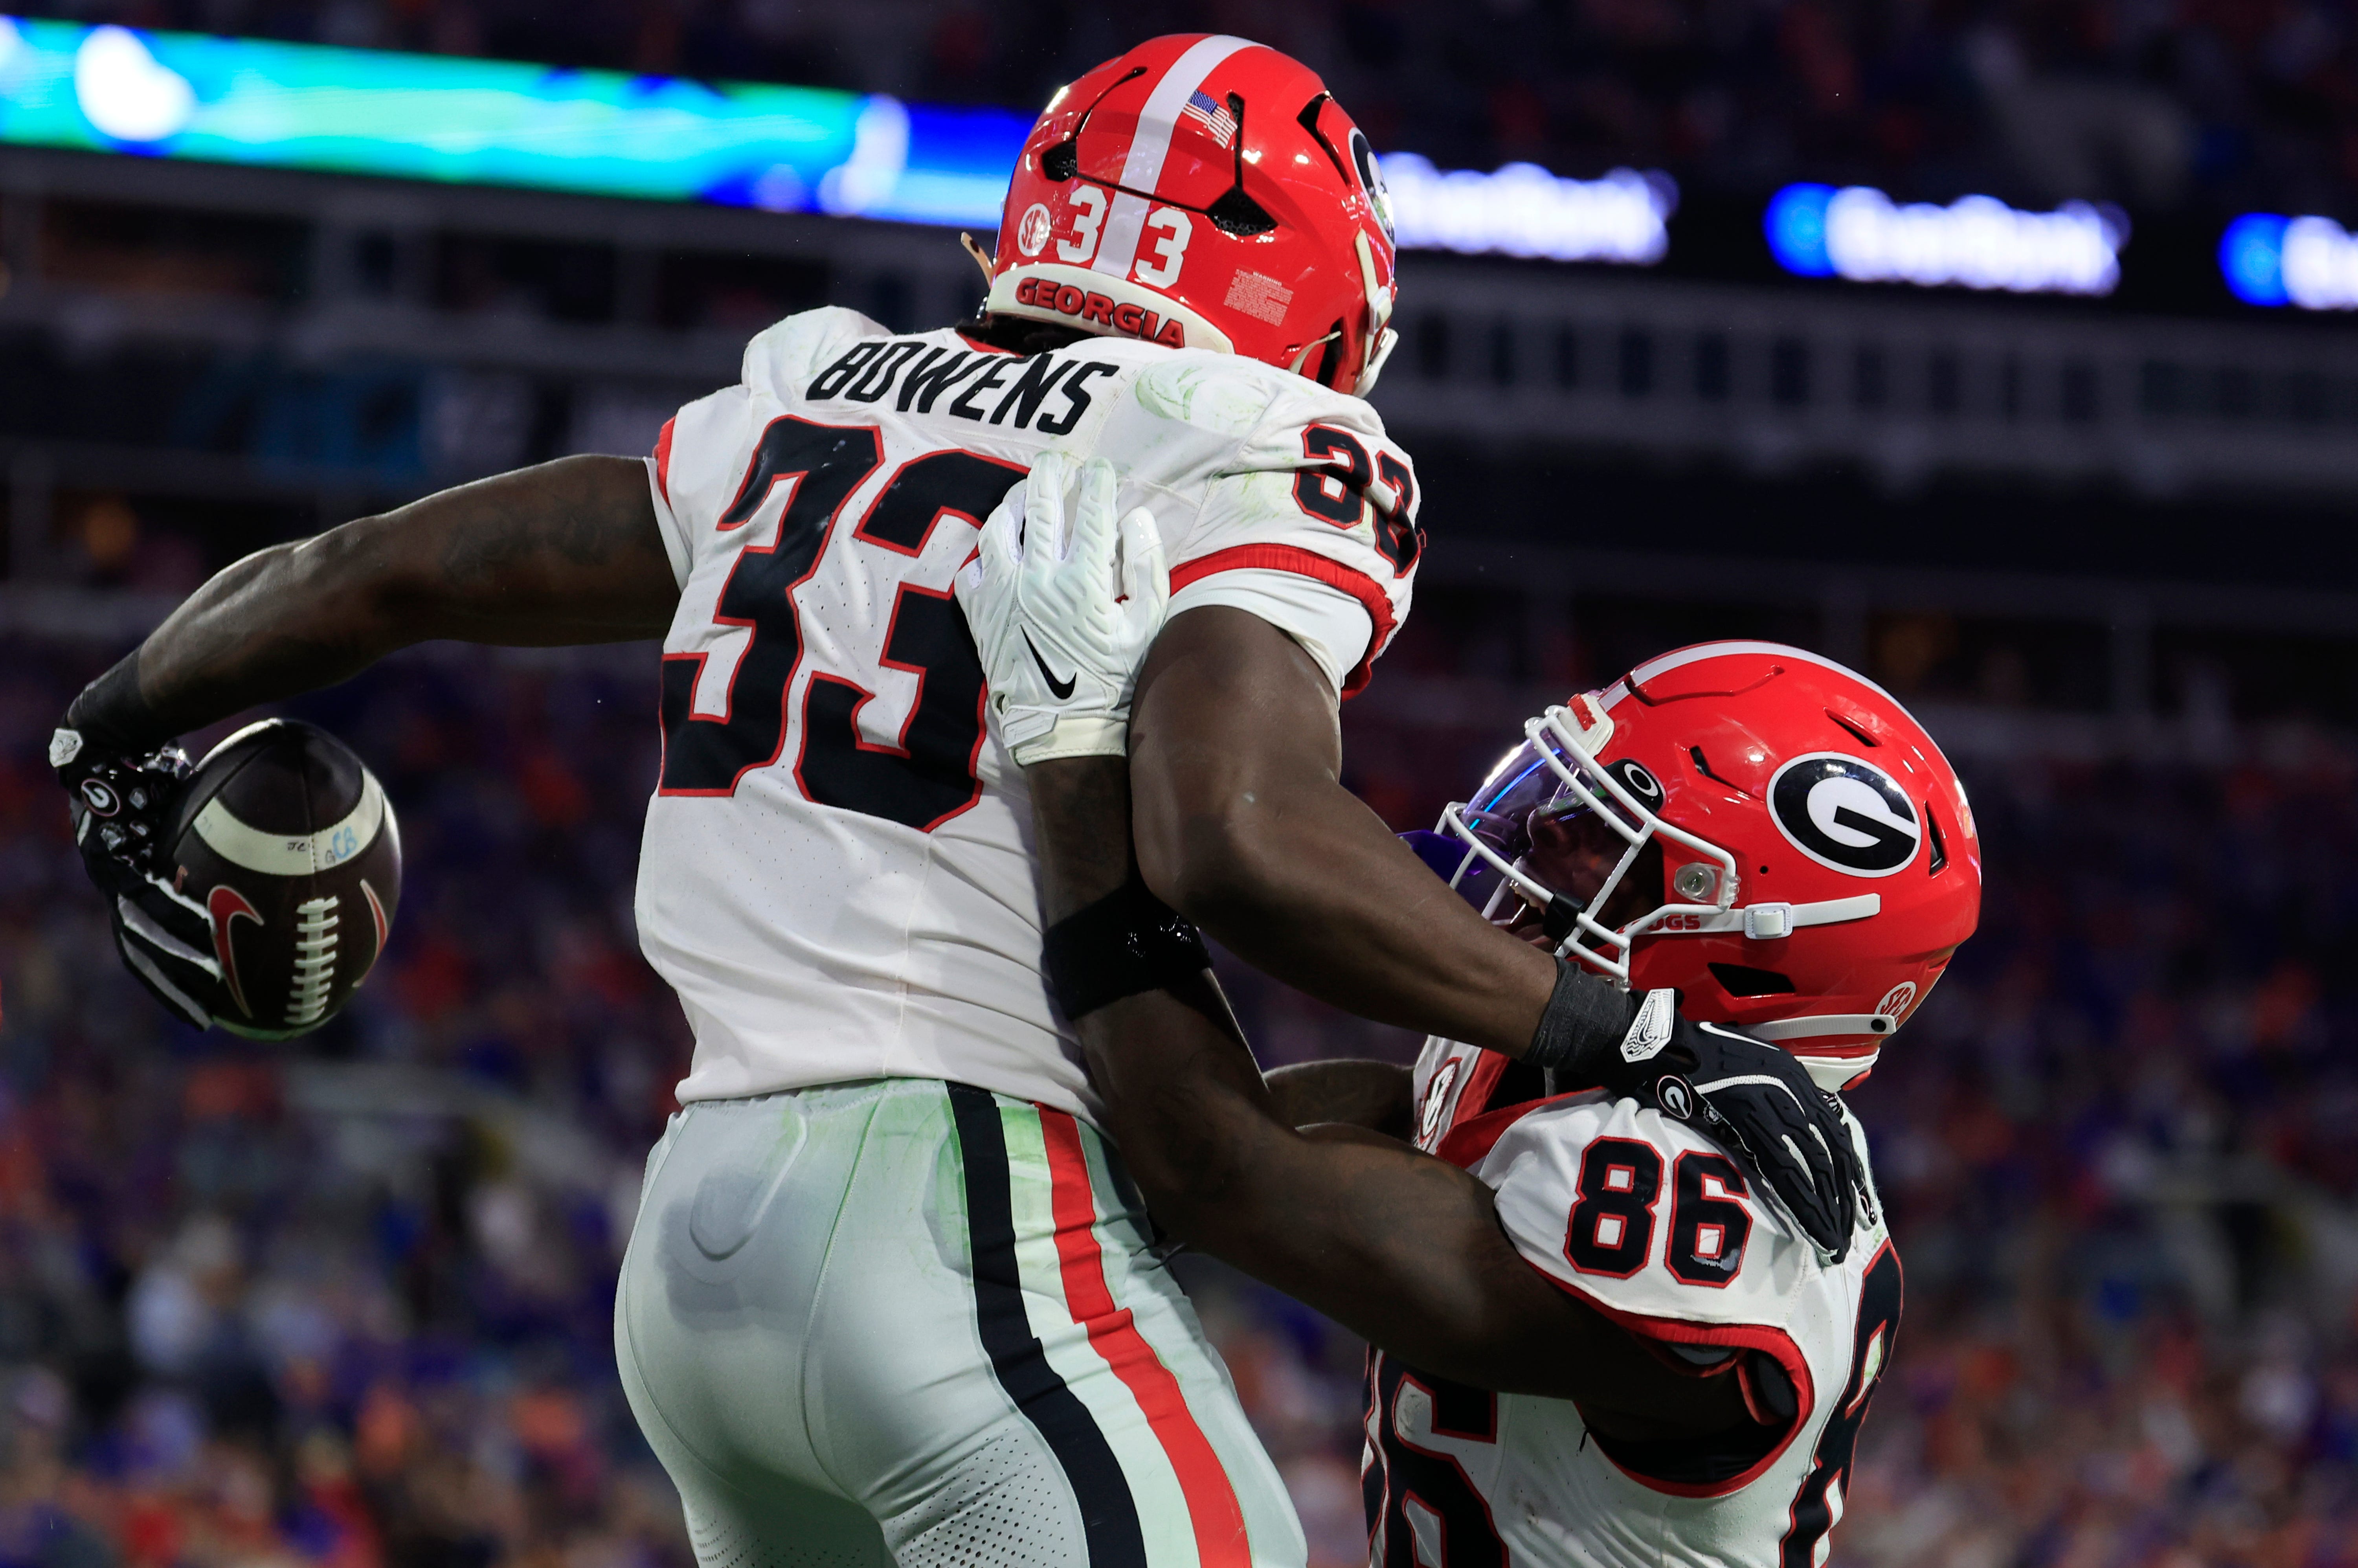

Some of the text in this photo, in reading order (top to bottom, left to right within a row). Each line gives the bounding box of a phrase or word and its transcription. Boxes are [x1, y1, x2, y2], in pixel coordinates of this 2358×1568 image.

[1015, 277, 1185, 349] GEORGIA
[805, 341, 1121, 435] BOWENS
[658, 414, 1030, 832] 33
[1563, 1136, 1754, 1288] 86
